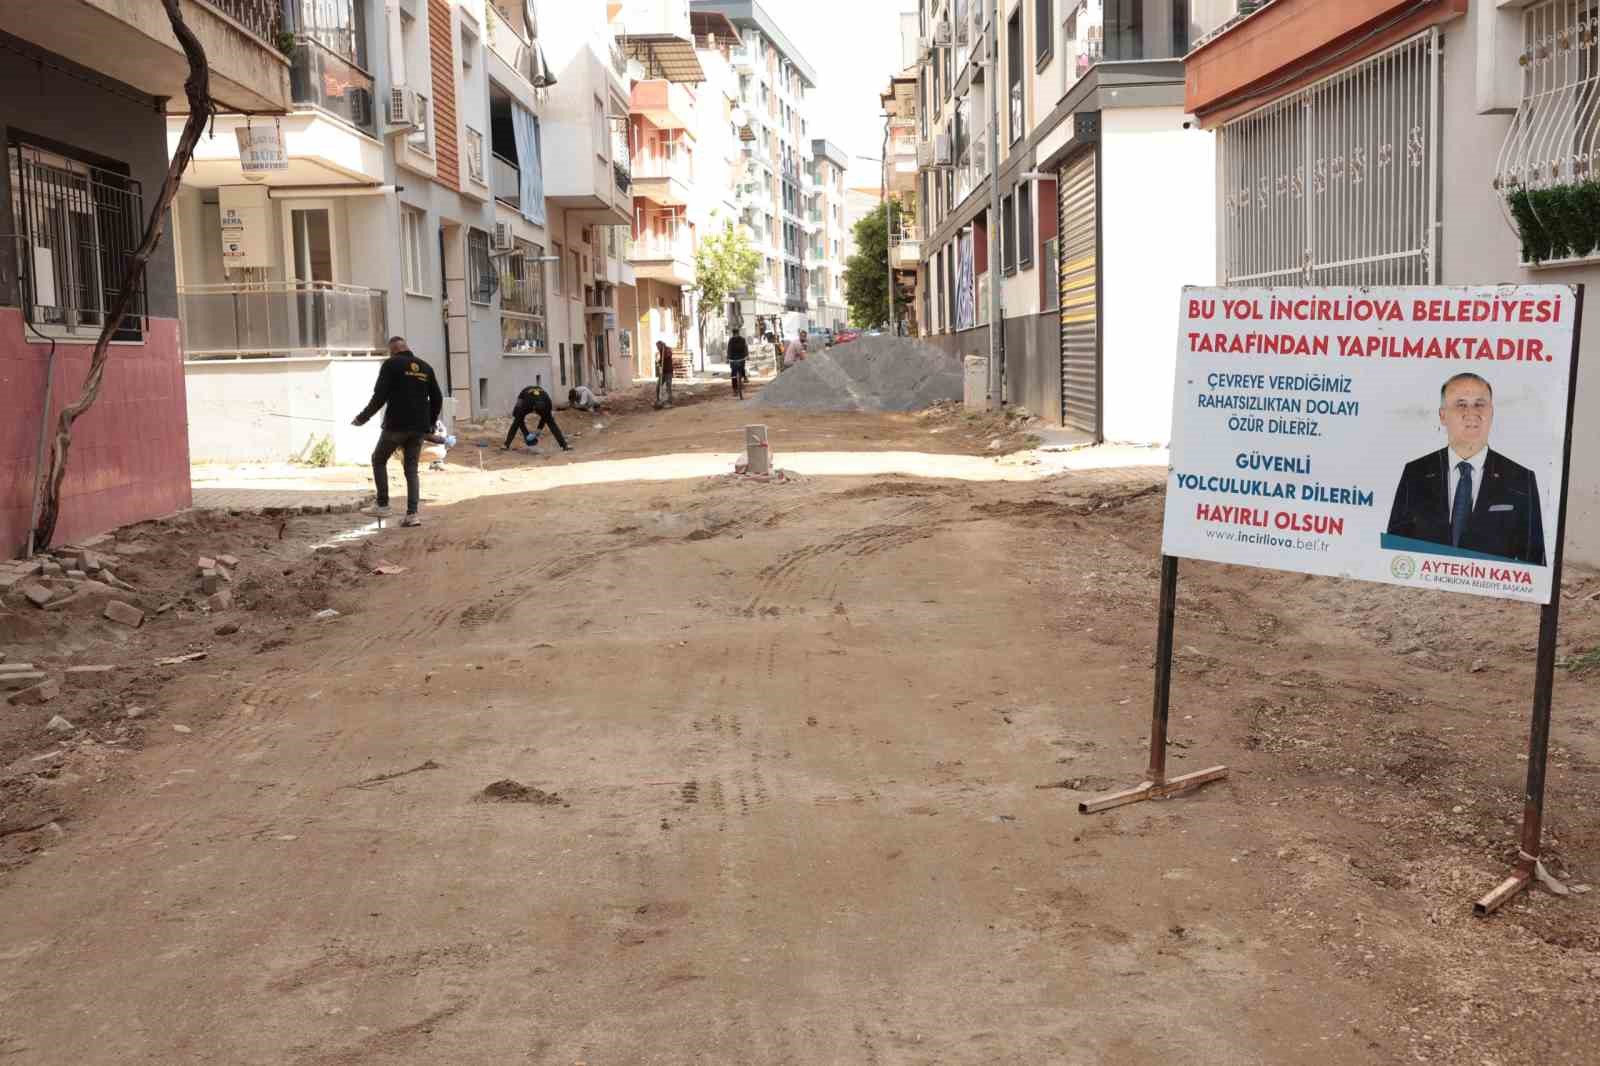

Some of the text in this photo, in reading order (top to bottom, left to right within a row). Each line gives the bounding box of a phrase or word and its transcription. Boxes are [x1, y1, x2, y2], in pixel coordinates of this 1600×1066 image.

[1188, 295, 1561, 323] BU YOL İNCİRLİOVA BELEDİYESİ
[1188, 332, 1553, 363] TARAFINDAN YAPILMAKTADIR.
[1207, 372, 1353, 393] ÇEVREYE VERDİĞİMİZ
[1198, 394, 1360, 417] RAHATSIZLIKTAN DOLAYI
[1228, 413, 1322, 437] ÖZÜR DİLERİZ.
[1236, 451, 1312, 475] GÜVENLİ
[1177, 473, 1374, 507] YOLCULUKLAR DİLERİM
[1196, 503, 1344, 537] HAYIRLI OLSUN
[1206, 528, 1330, 552] www.incirliova.bel.tr
[1421, 560, 1532, 585] AYTEKİN KAYA
